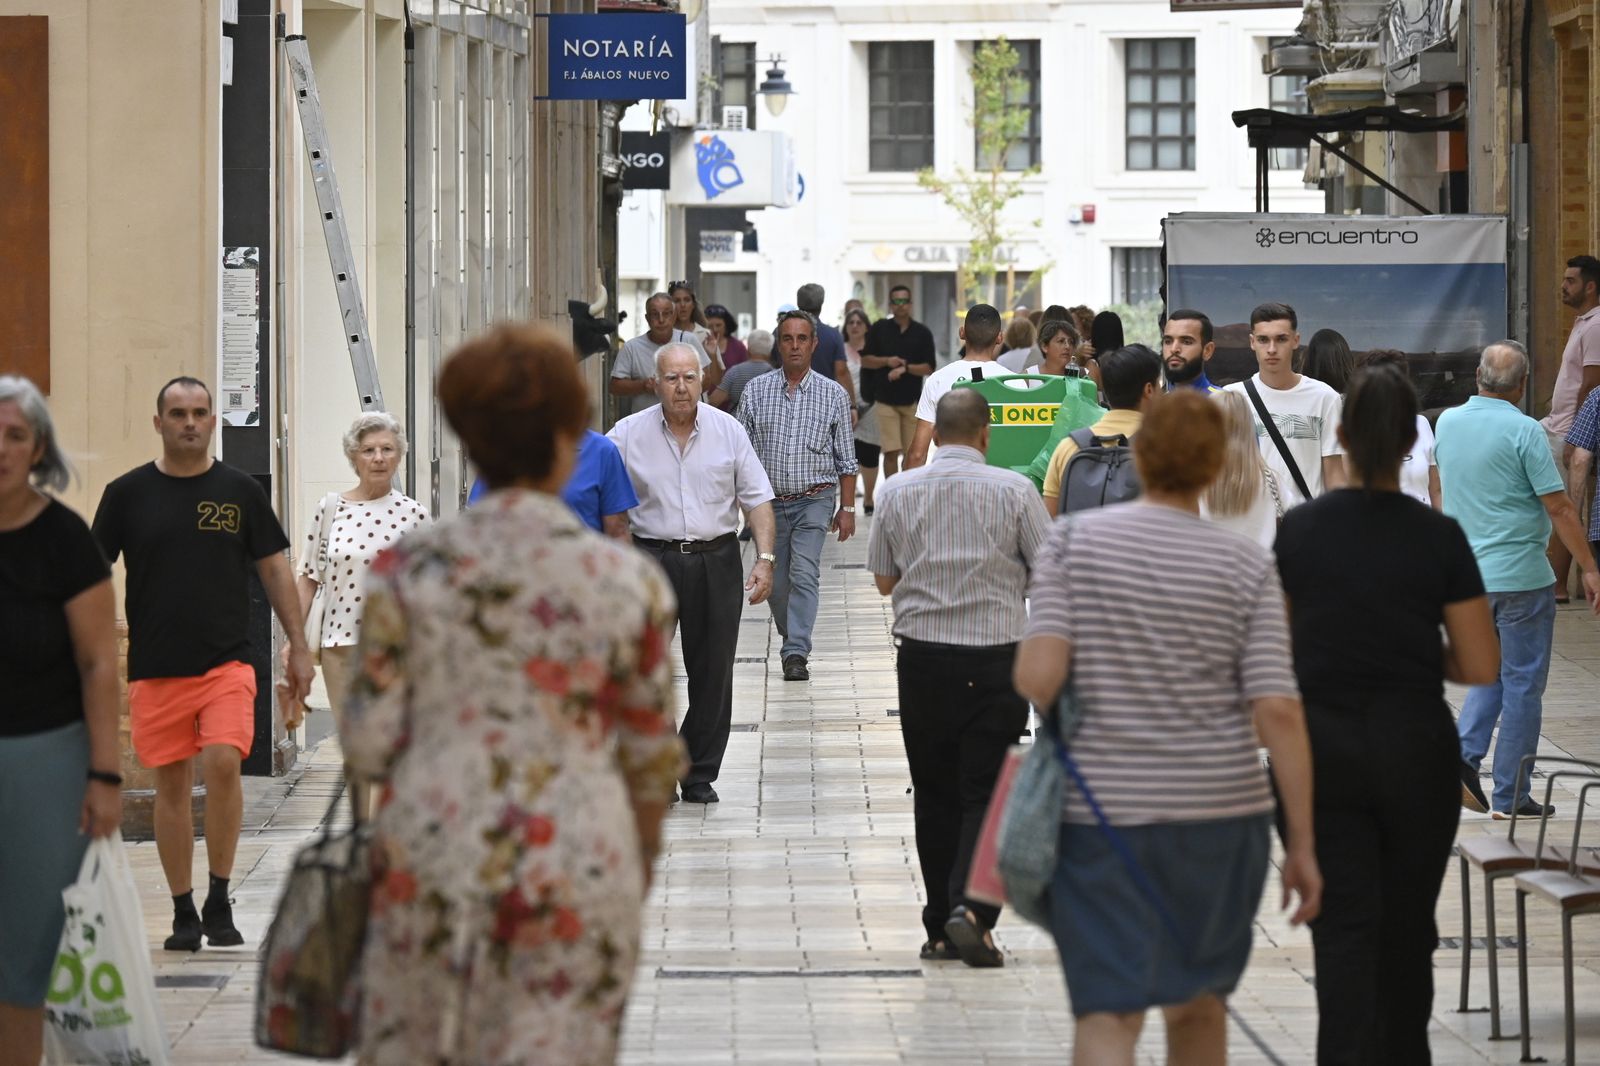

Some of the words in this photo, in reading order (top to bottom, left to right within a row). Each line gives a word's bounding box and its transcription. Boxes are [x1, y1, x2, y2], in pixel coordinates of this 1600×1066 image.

[564, 35, 673, 58] NOTARÍA
[580, 67, 622, 80] ÁBALOS
[628, 70, 670, 80] NUEVO
[1278, 228, 1419, 245] encuentro
[197, 501, 240, 534] 23
